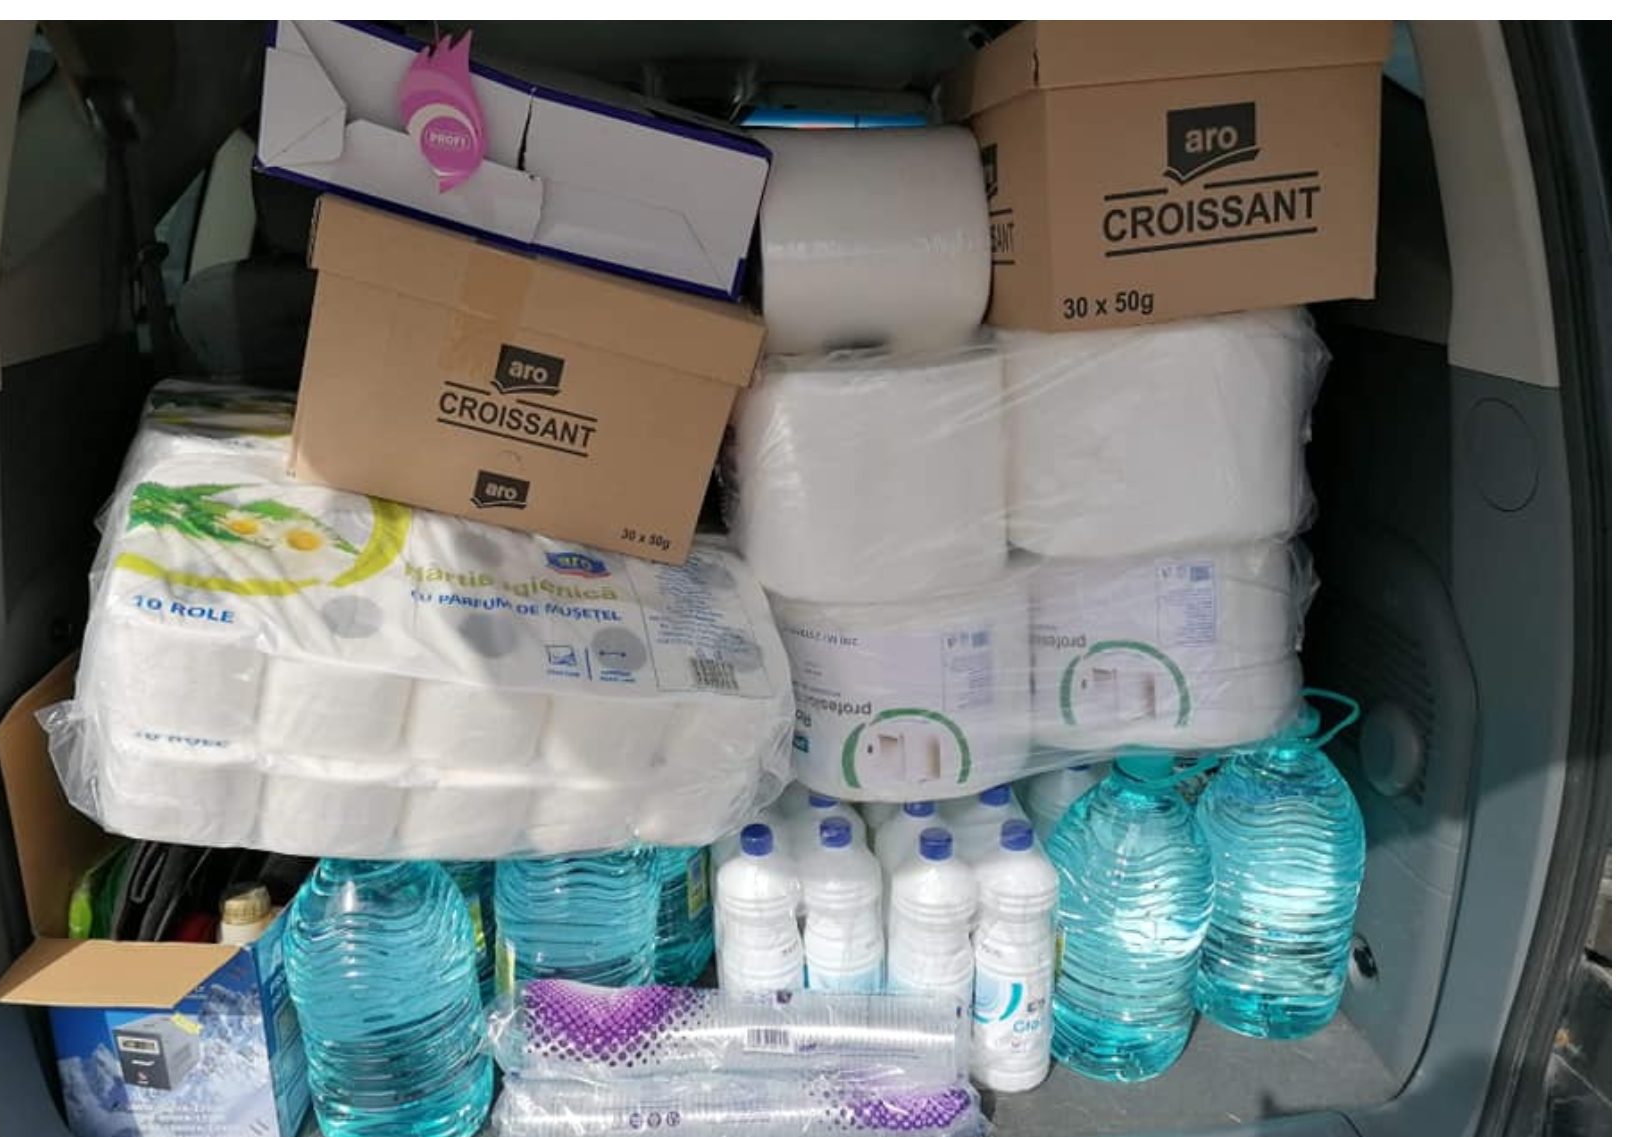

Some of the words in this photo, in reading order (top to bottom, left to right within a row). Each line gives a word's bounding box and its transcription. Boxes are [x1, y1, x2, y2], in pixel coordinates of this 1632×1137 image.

[1184, 123, 1239, 153] aro
[1102, 185, 1321, 242] CROISSANT
[1063, 297, 1088, 319] 30
[1095, 302, 1107, 316] x
[1115, 290, 1154, 314] 50g
[508, 359, 548, 383] aro
[439, 391, 596, 448] CROISSANT
[485, 481, 517, 500] aro
[133, 594, 162, 611] 10
[169, 601, 235, 624] ROLE
[517, 603, 539, 615] DE
